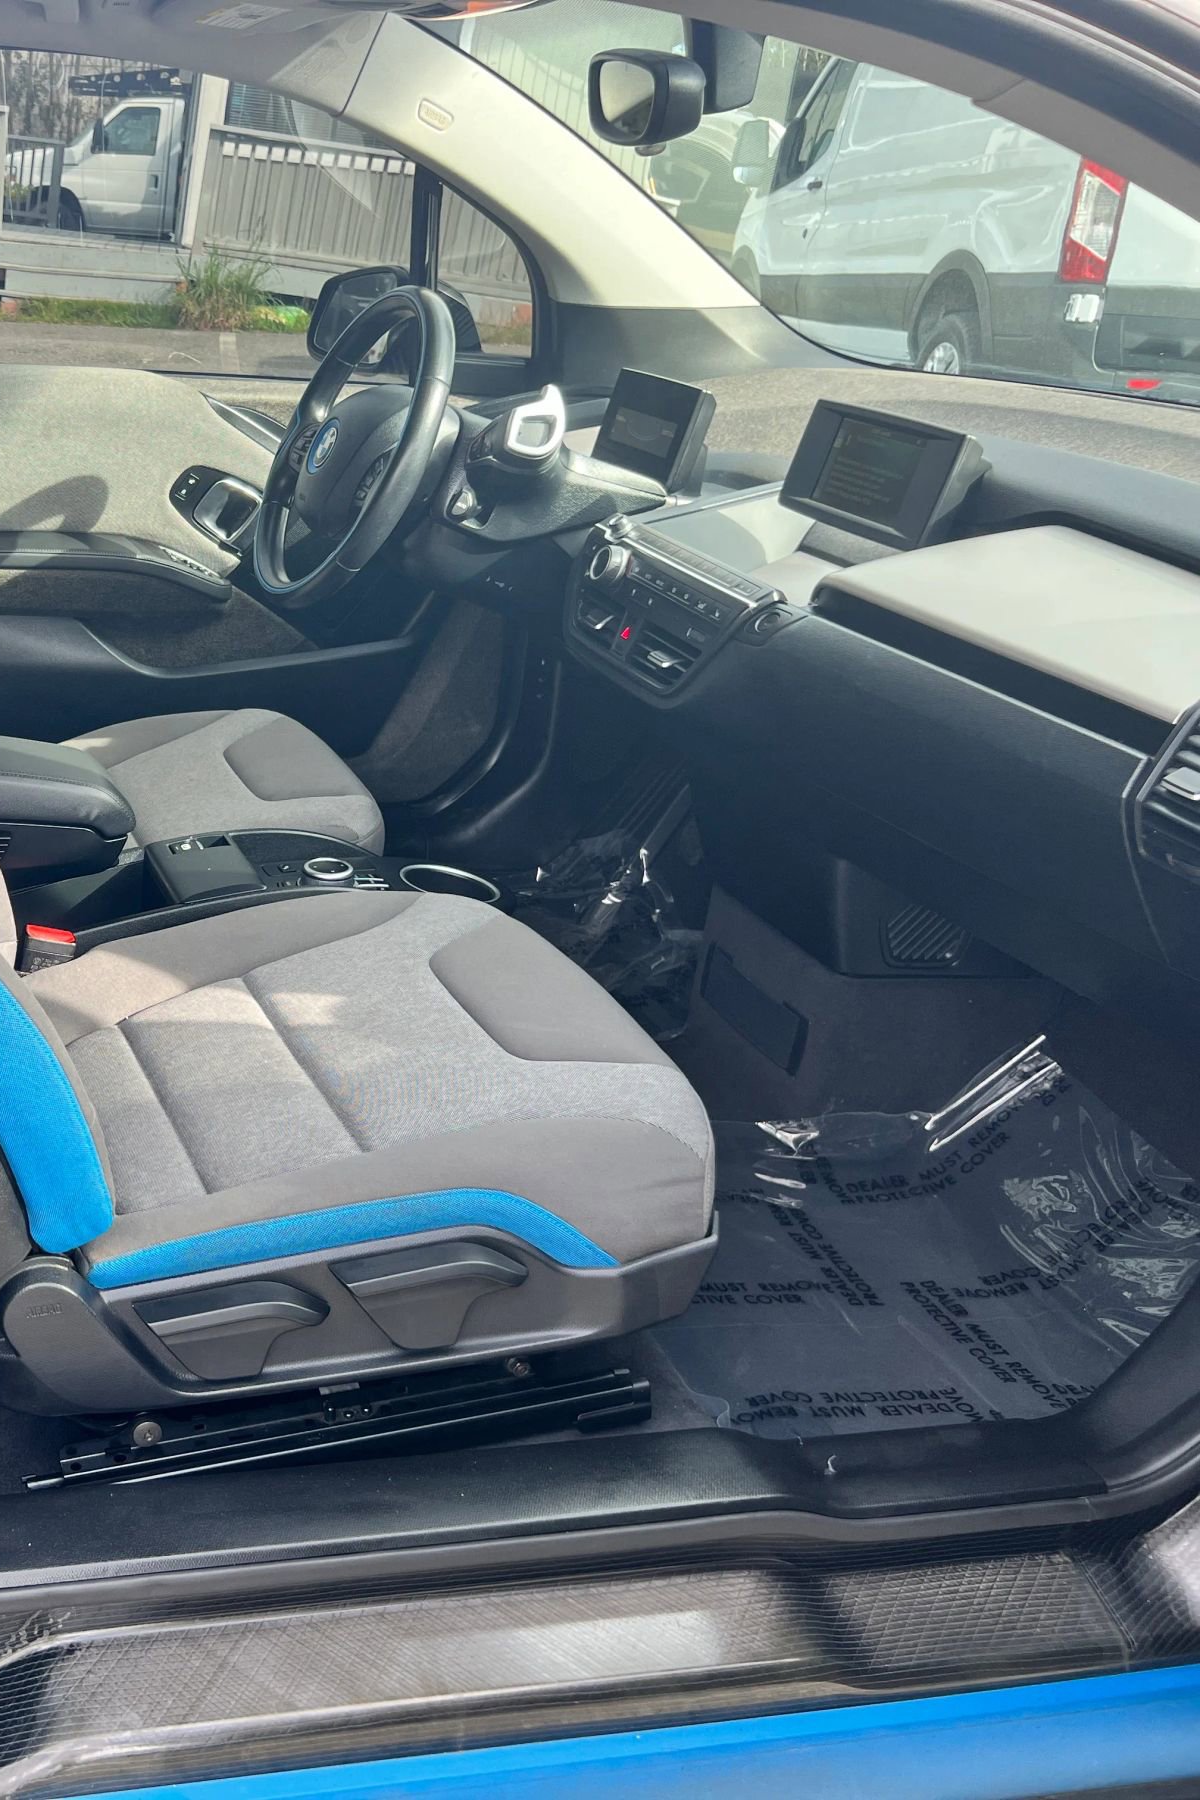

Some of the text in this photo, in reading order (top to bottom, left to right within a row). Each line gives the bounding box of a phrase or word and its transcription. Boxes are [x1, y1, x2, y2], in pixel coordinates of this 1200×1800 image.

[960, 1131, 1011, 1175] COVER
[848, 1174, 910, 1194] DEALER
[919, 1150, 965, 1182] MUST
[788, 1231, 825, 1261] MUST
[757, 1279, 837, 1295] REMOVE
[818, 1243, 886, 1307] PROTECTIVE
[820, 1265, 865, 1307] DEALER
[978, 1266, 1041, 1286] COVER
[1039, 1257, 1088, 1290] MUST
[743, 1293, 807, 1306] COVER
[951, 1281, 1030, 1298] REMOVE
[900, 1281, 1018, 1384] PROTECTIVE COVER
[919, 1280, 1068, 1410] DEALER MUST REMOVE
[744, 1389, 940, 1407] PROTECTIVE COVER
[811, 1404, 866, 1418] MUST
[879, 1402, 954, 1416] DEALER
